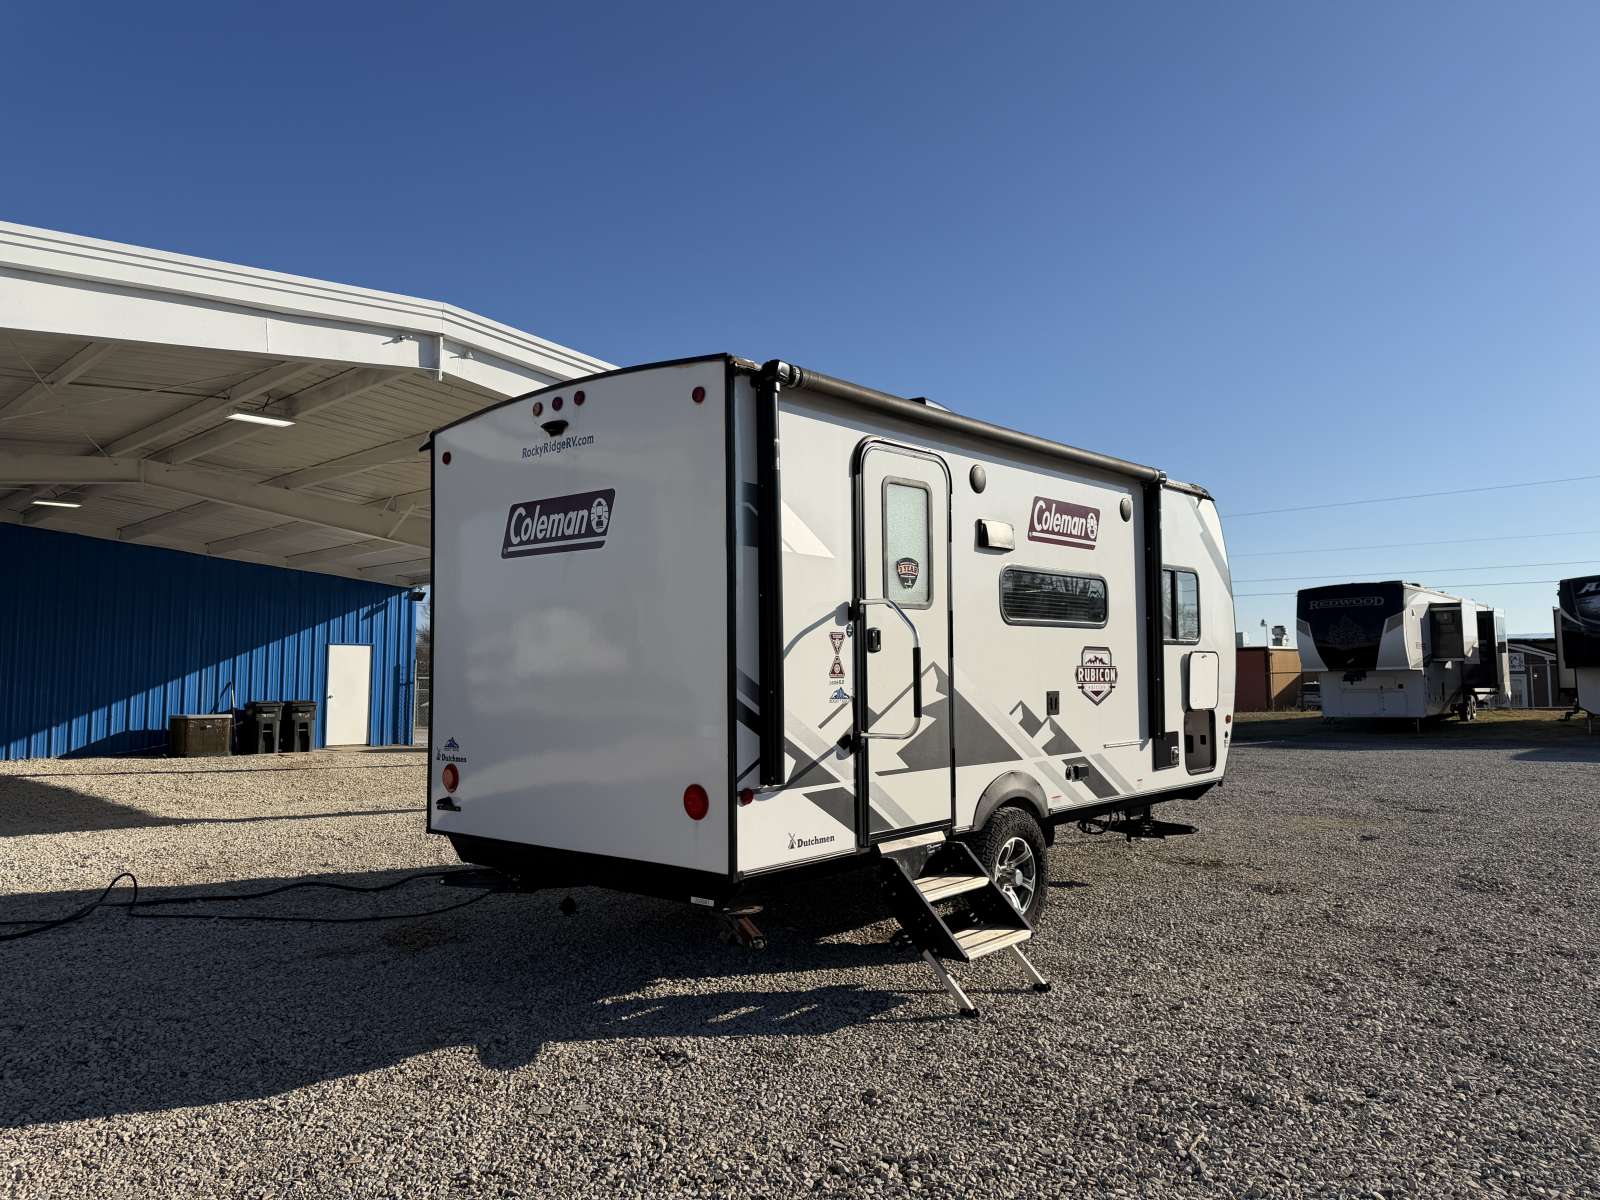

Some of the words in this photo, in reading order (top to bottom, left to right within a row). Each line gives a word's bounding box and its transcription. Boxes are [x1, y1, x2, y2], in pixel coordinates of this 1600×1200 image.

[522, 434, 594, 458] RockyRidgeRV.com
[510, 504, 588, 545] Coleman
[1034, 500, 1086, 537] Coleman
[1308, 596, 1385, 610] REDWOOD
[1078, 668, 1116, 682] RUBICON
[797, 835, 835, 848] Dutchmen
